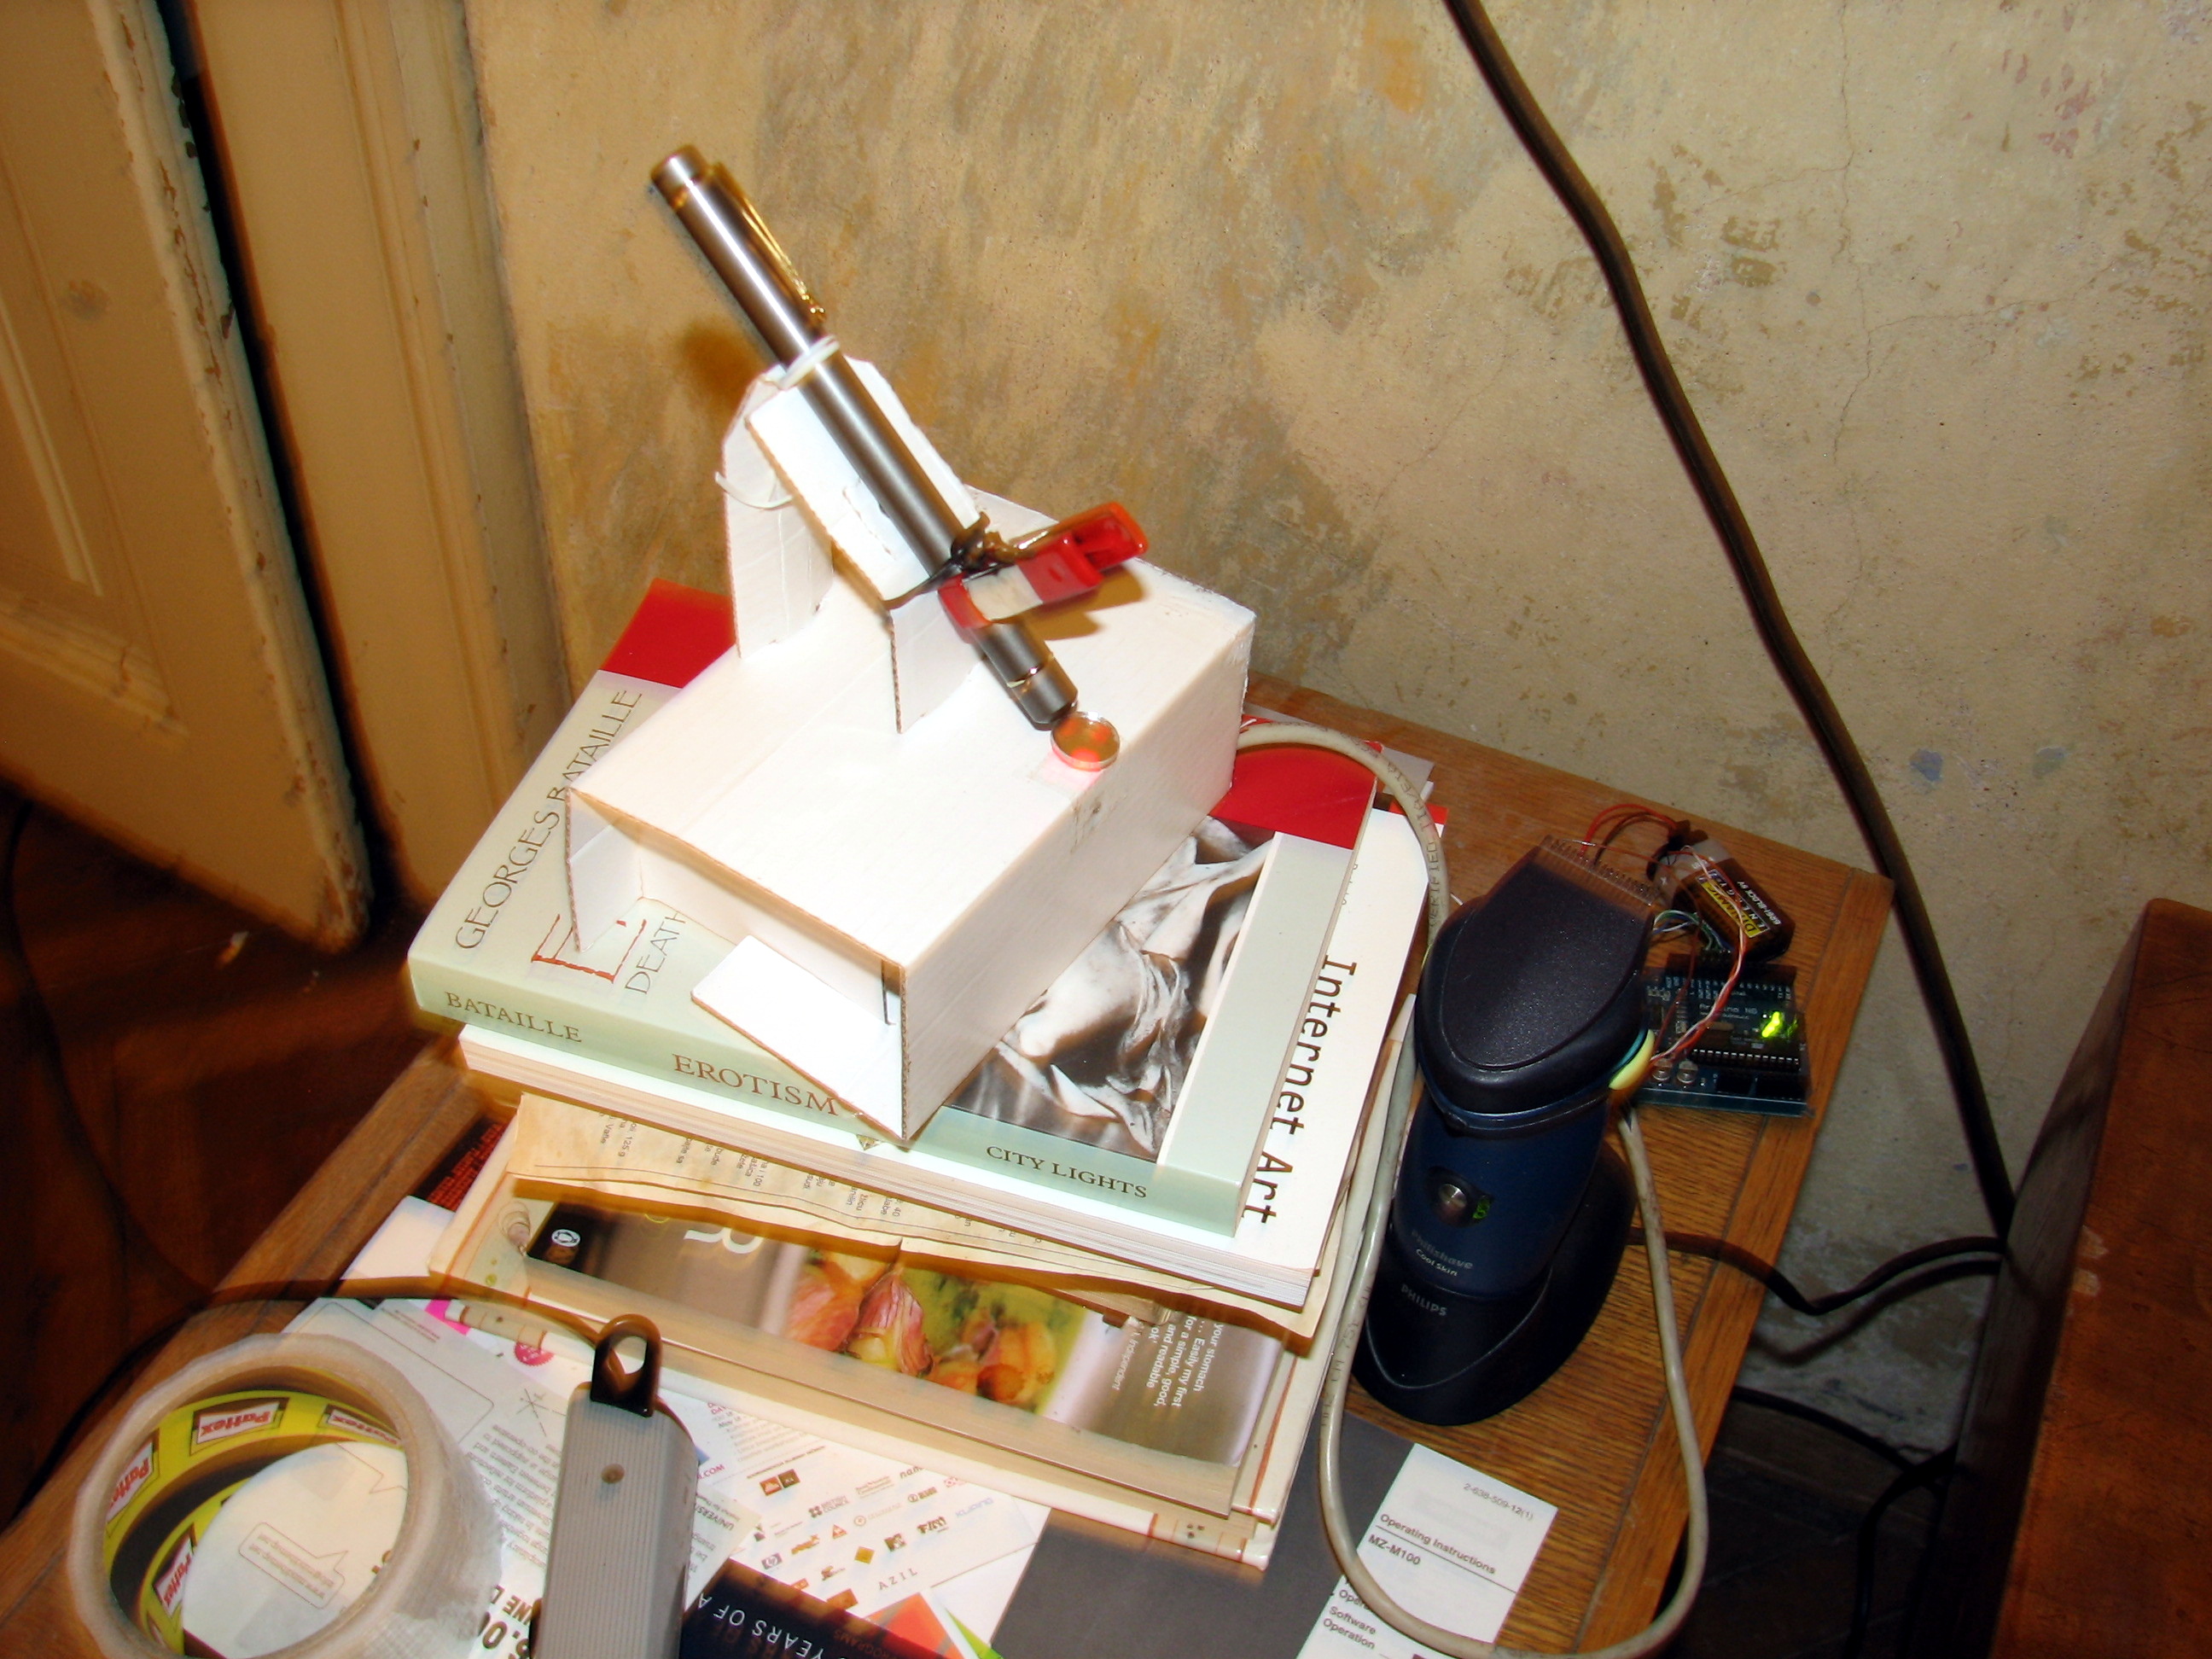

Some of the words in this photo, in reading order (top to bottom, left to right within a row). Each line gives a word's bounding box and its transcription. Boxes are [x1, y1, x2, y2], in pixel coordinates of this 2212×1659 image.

[454, 809, 560, 951] GEORGES
[546, 689, 643, 805] BATAILLE
[445, 990, 583, 1044] BATAILLE
[1274, 953, 1358, 1136] Internet
[672, 1052, 840, 1118] EROTISM
[985, 1144, 1047, 1171] CITY
[1050, 1160, 1149, 1200] LIGHTS
[1243, 1151, 1295, 1225] Art
[1400, 1284, 1448, 1316] PHILIPS
[1163, 1324, 1177, 1344] and
[1184, 1315, 1196, 1330] for
[1210, 1323, 1224, 1347] your
[1145, 1344, 1168, 1389] readable
[1165, 1341, 1186, 1376] simple,
[1185, 1337, 1205, 1367] Easily
[1179, 1368, 1192, 1385] my
[1193, 1348, 1215, 1392] stomach
[1171, 1386, 1188, 1407] first
[200, 1410, 271, 1437] Pattex
[1368, 1534, 1421, 1566] MZ-M100
[1379, 1513, 1431, 1545] Operating
[1432, 1538, 1496, 1575] Instructions
[879, 1567, 919, 1591] AZIL
[712, 1603, 746, 1627] OF
[1328, 1604, 1377, 1635] Software
[751, 1618, 826, 1659] YEARS
[1323, 1616, 1376, 1650] Operation
